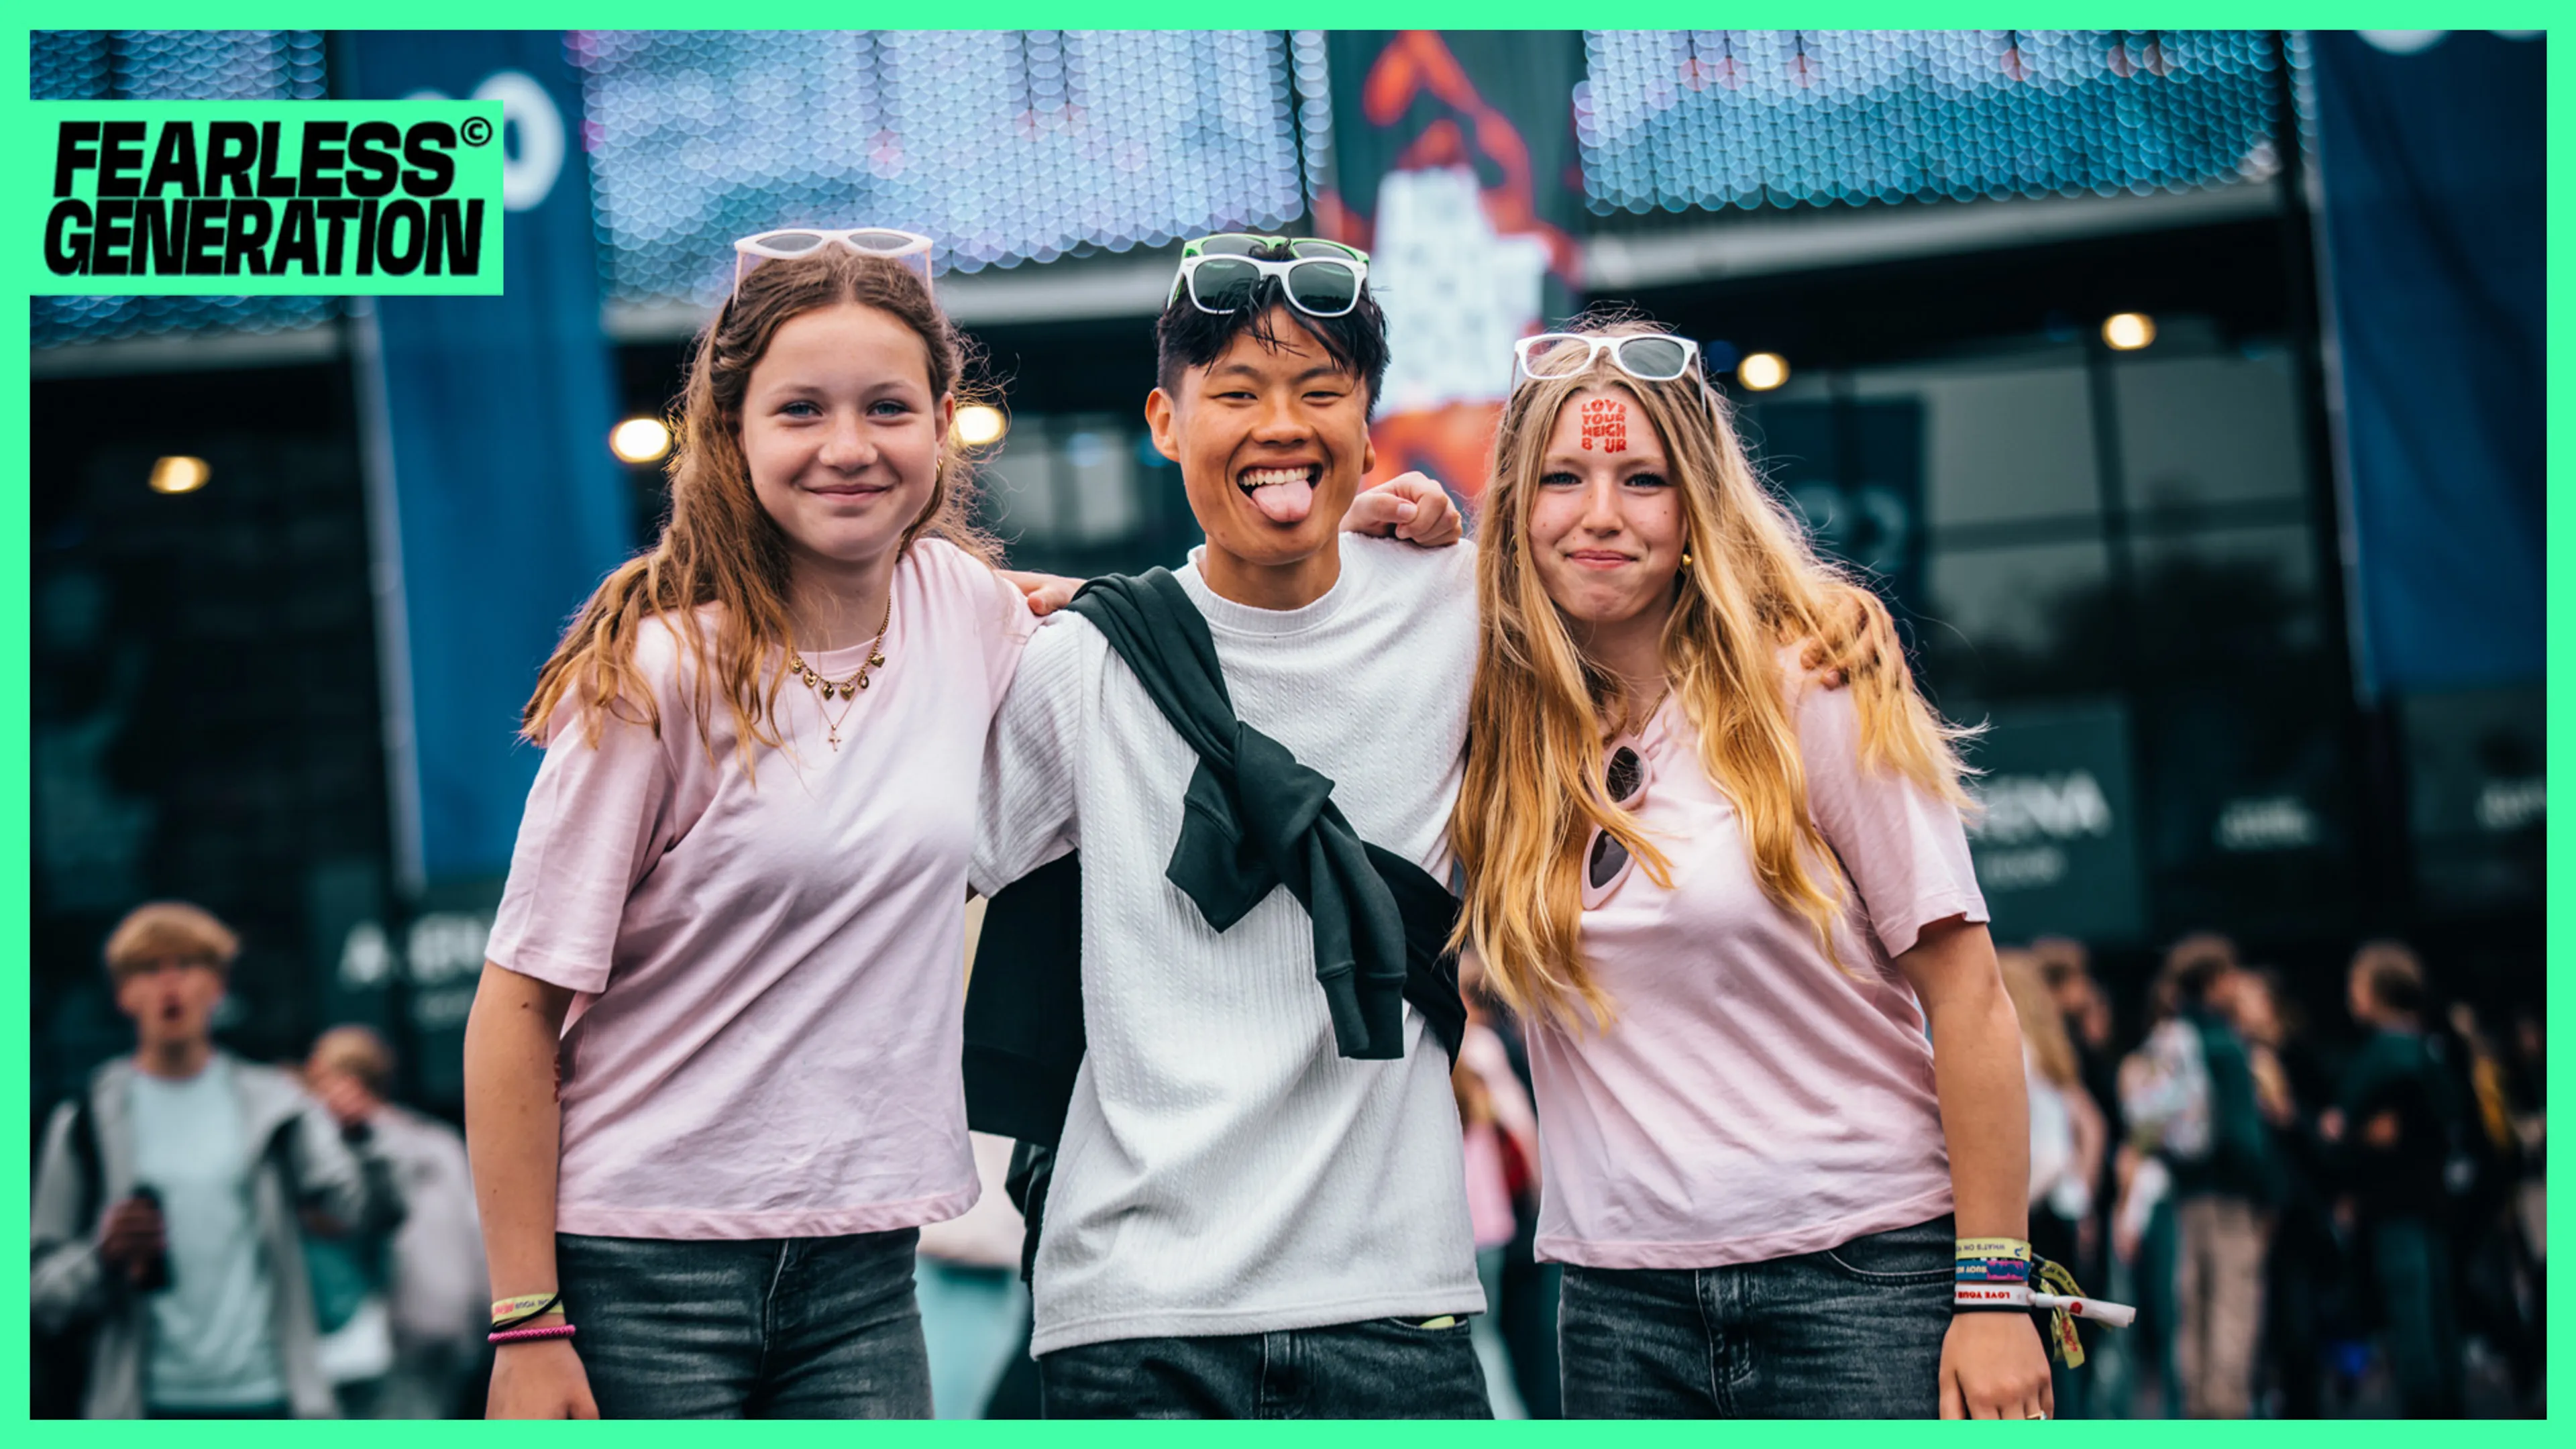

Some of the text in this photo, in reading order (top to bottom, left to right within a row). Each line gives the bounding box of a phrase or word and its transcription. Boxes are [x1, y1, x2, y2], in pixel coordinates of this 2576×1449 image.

[1582, 413, 1625, 425] YOUR
[1582, 438, 1626, 453] BUR
[1984, 1291, 2010, 1299] LOVE
